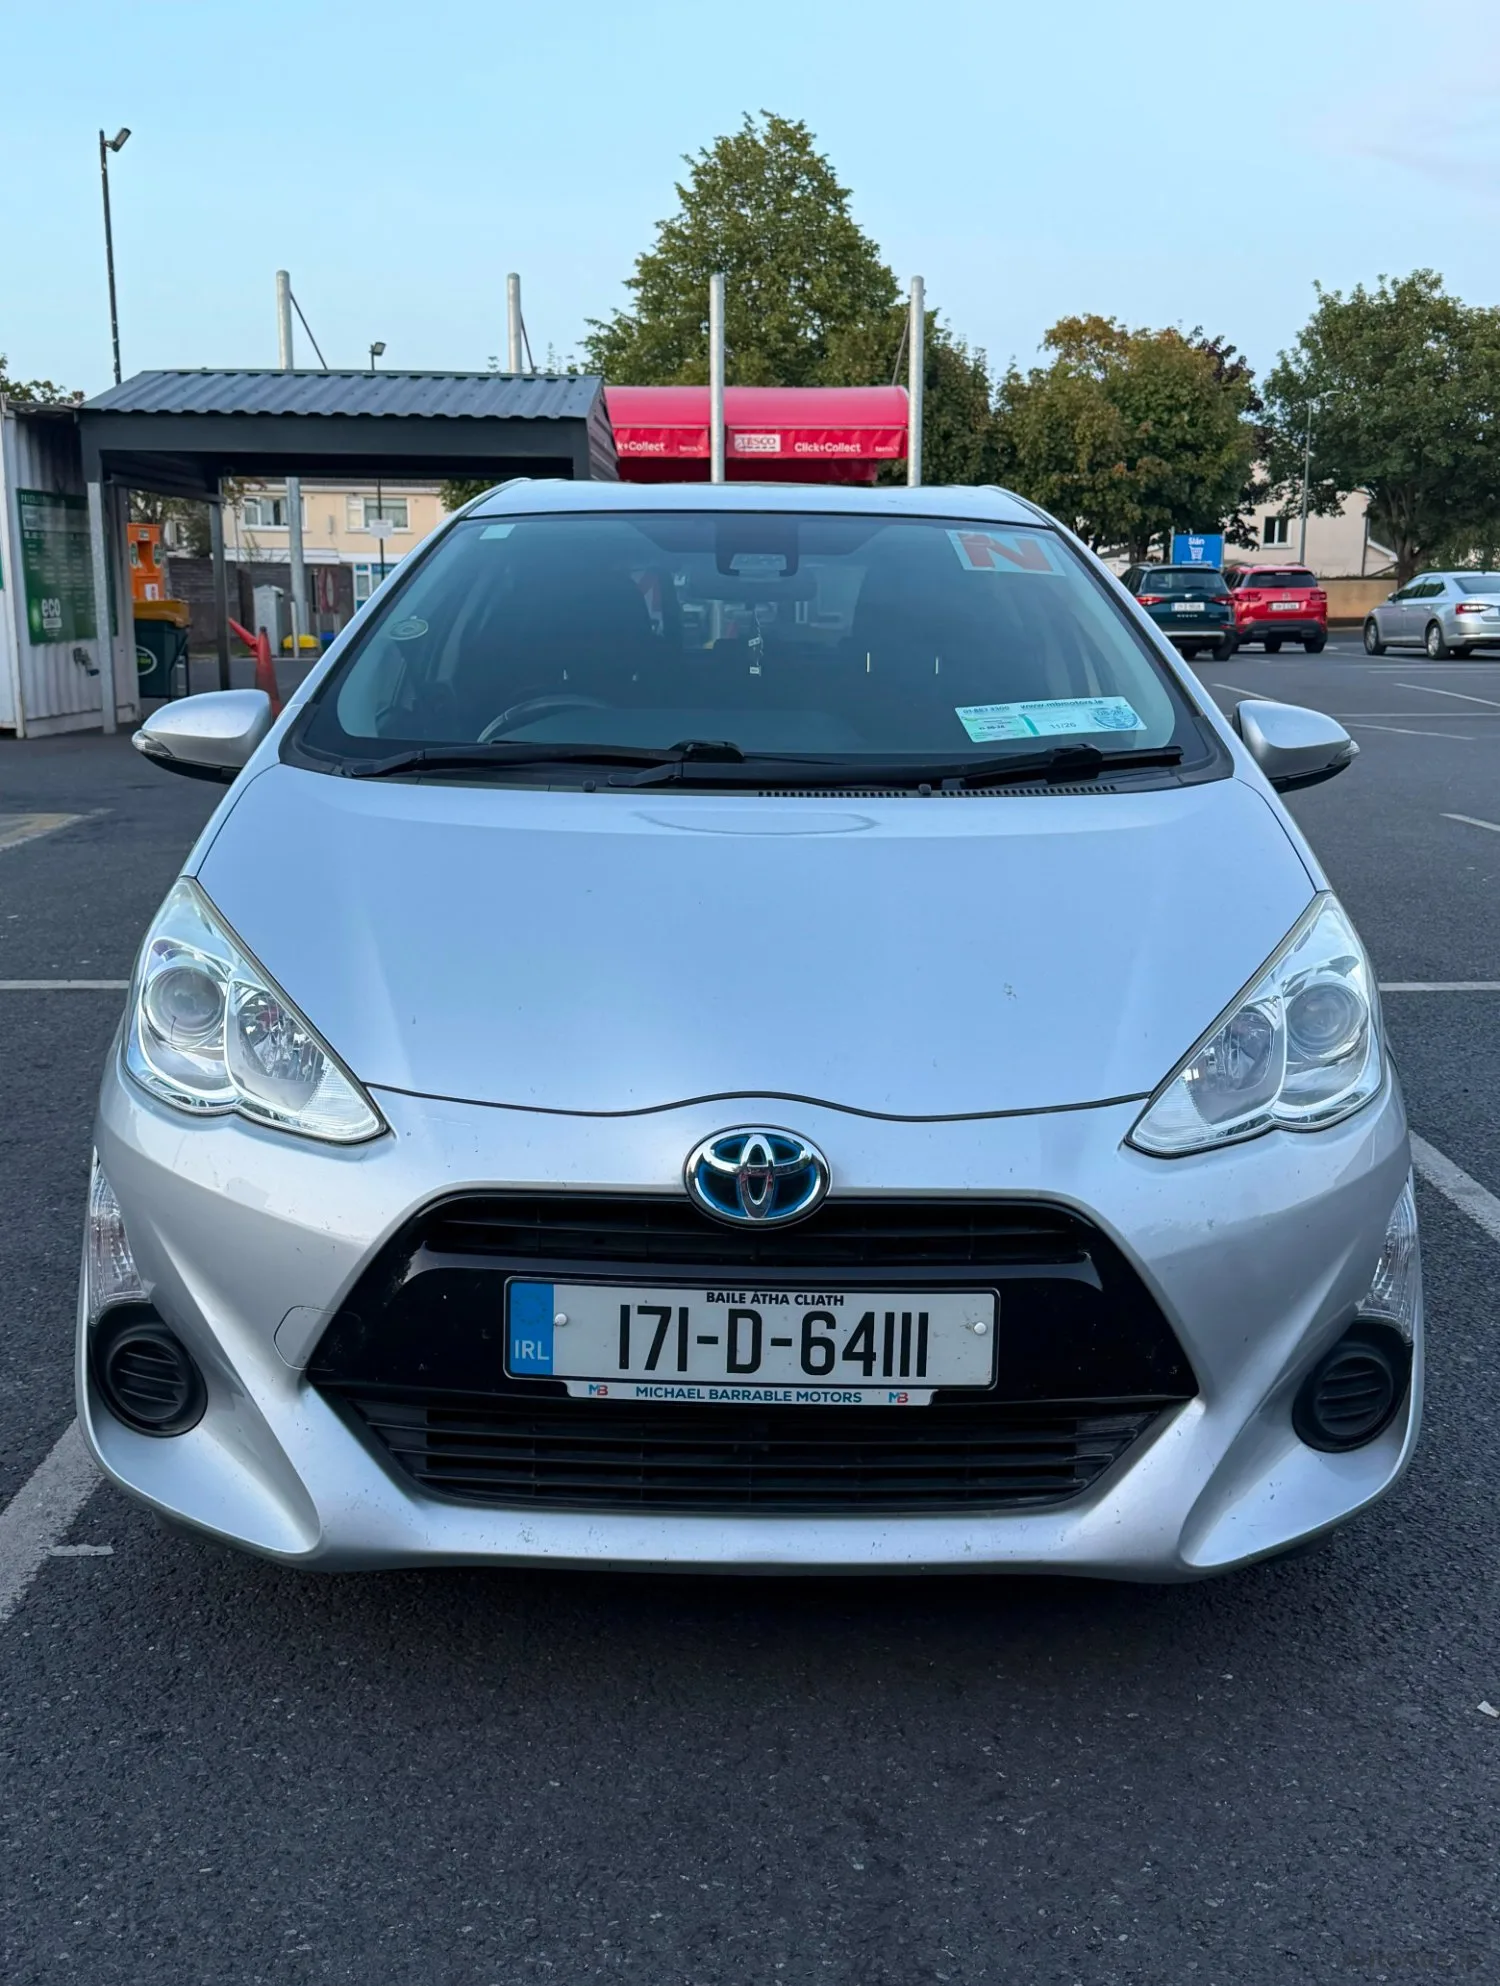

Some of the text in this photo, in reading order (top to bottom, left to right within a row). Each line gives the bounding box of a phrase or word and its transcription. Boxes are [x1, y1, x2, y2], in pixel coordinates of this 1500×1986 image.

[617, 441, 665, 451] k+Collect
[795, 442, 861, 453] Click+Collect
[957, 532, 1054, 571] N
[41, 598, 61, 617] eco
[706, 1291, 844, 1306] BAILE ÁTHA CLIATH
[514, 1339, 550, 1361] IRL
[619, 1304, 929, 1378] 171-D-64111
[588, 1384, 909, 1404] MB MICHAEL BARRABLE MOTORS MB
